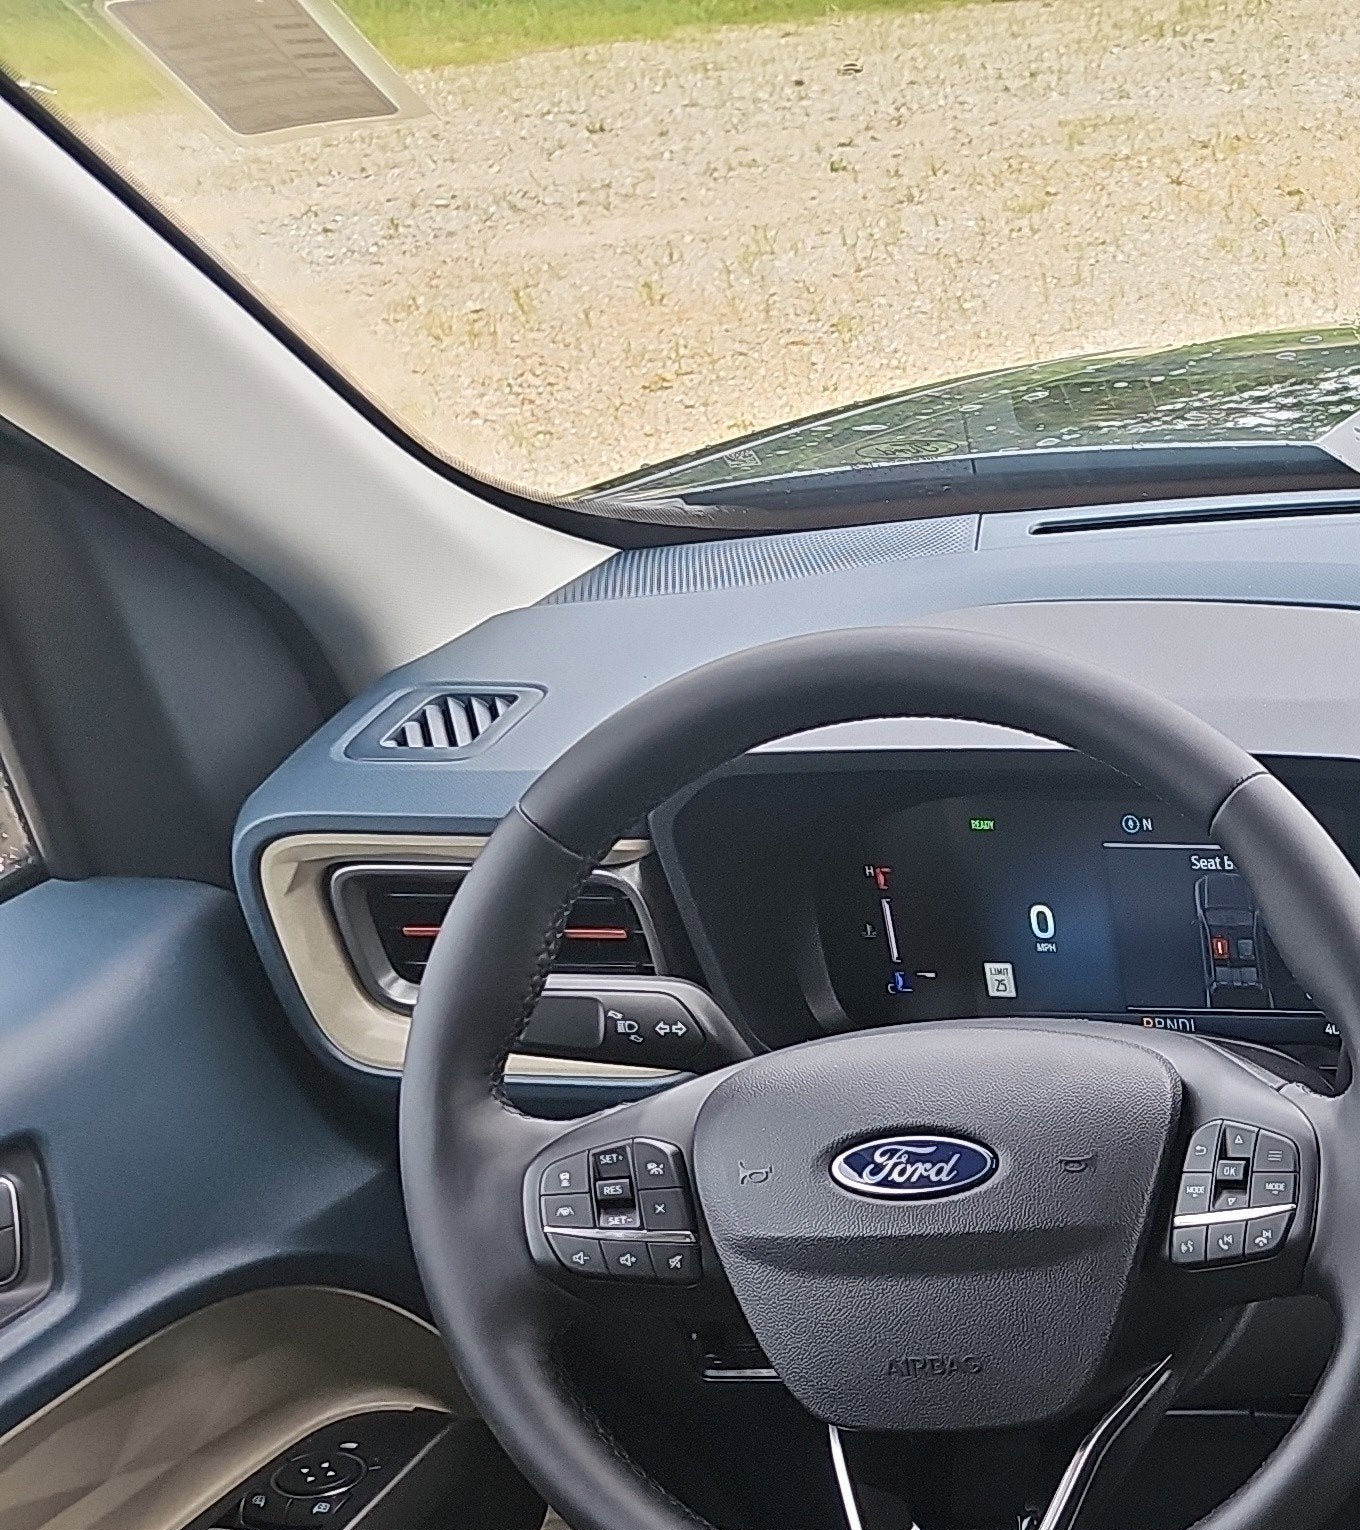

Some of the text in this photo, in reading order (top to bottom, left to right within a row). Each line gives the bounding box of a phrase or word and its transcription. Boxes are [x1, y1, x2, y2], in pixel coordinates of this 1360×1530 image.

[971, 820, 995, 830] READY
[1142, 819, 1152, 831] N
[1191, 856, 1222, 870] Seat
[1030, 904, 1055, 939] 0
[1036, 943, 1057, 952] MPH
[994, 979, 1007, 992] 25
[863, 1144, 958, 1184] Ford
[1224, 1167, 1236, 1177] OK
[603, 1185, 622, 1195] RES
[1186, 1185, 1205, 1194] MODE
[1266, 1182, 1285, 1191] MODE
